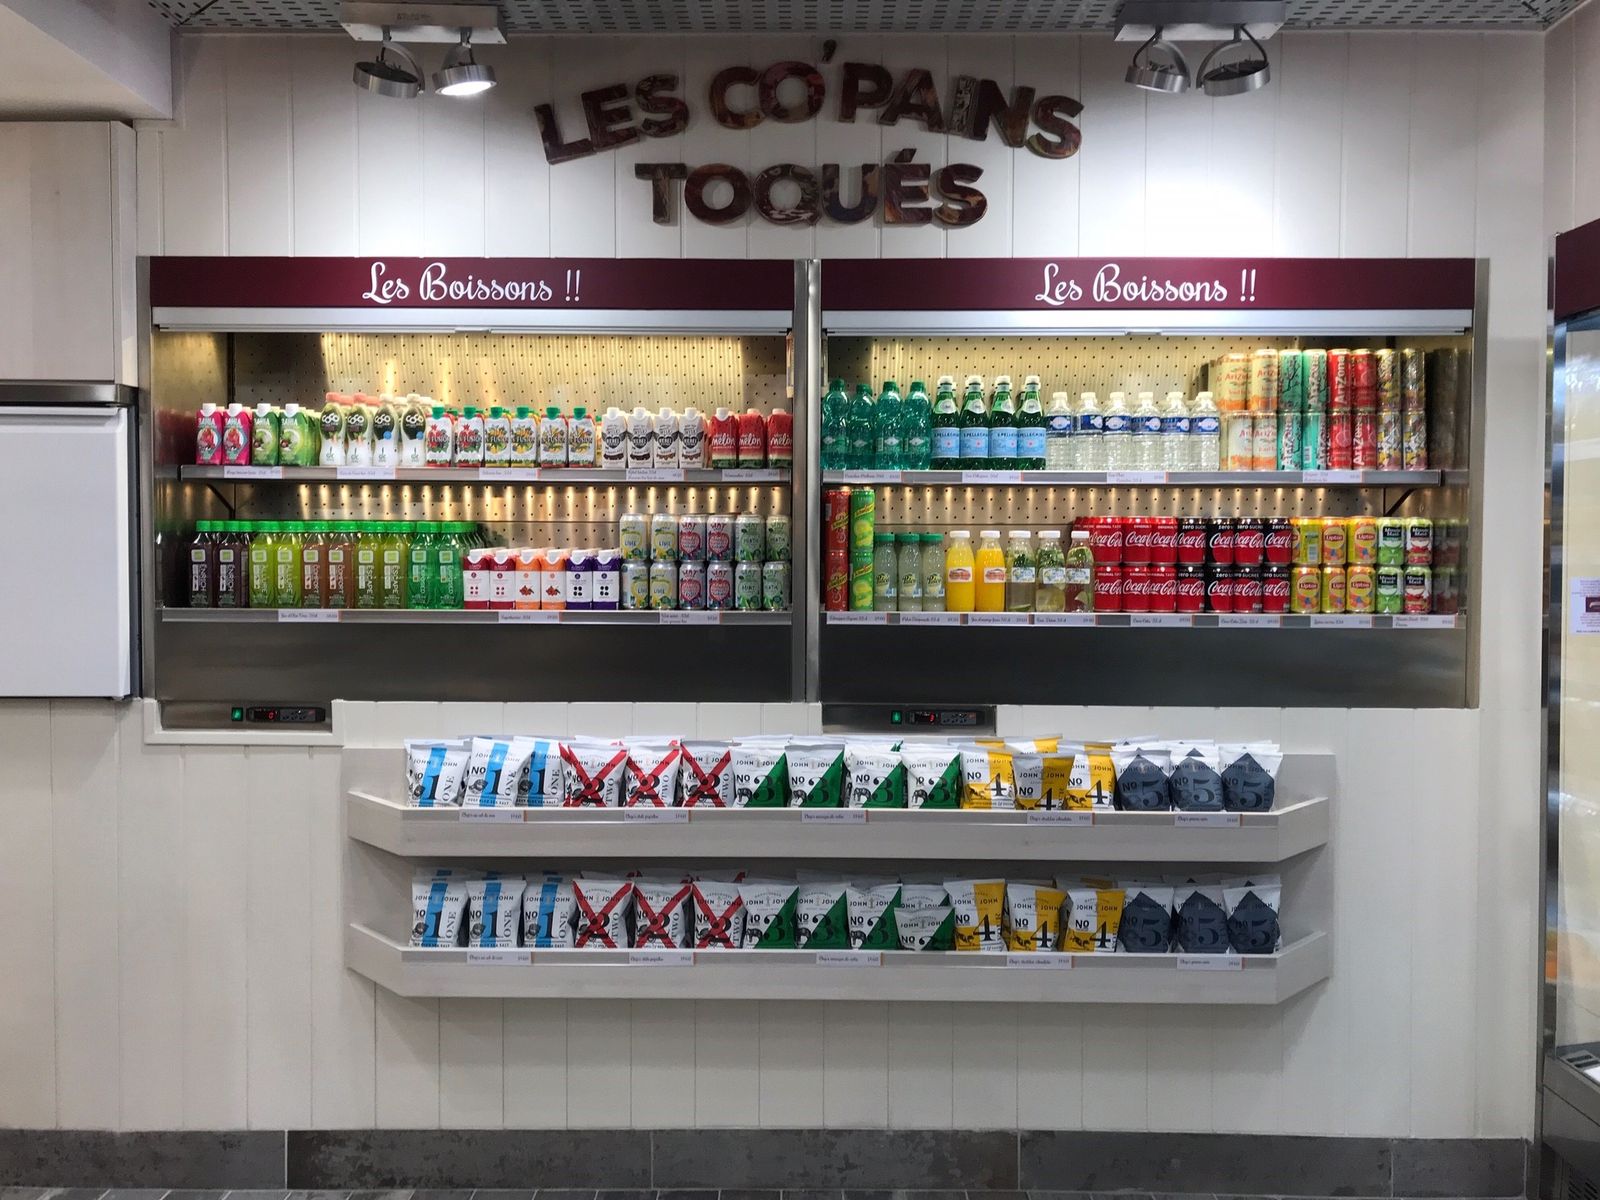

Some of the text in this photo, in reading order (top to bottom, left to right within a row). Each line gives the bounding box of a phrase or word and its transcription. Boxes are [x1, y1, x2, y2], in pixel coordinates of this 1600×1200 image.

[534, 39, 1085, 164] LES CO'PAINS
[634, 148, 988, 226] TOQUÉS
[362, 261, 580, 304] Les Boissons !!
[1035, 263, 1256, 306] Les Boissons !!
[471, 766, 486, 775] NO
[505, 770, 517, 797] ONE
[551, 769, 560, 796] ONE
[442, 776, 455, 801] ONE
[737, 774, 775, 800] NO 3
[791, 776, 830, 802] NO 3
[856, 775, 893, 802] NO 3
[928, 777, 949, 802] 3
[967, 772, 1007, 797] NO 4
[1068, 778, 1108, 805] NO 4
[1122, 779, 1164, 807] NO 5
[1175, 777, 1215, 803] NO 5
[1224, 777, 1262, 808] NO 5
[1019, 787, 1056, 810] NO 4
[446, 912, 456, 938] ONE
[504, 911, 512, 937] ONE
[525, 911, 538, 920] NO
[559, 912, 568, 938] ONE
[764, 914, 785, 941] 3
[813, 914, 833, 942] 3
[956, 914, 995, 941] NO 4
[851, 916, 888, 944] NO 3
[902, 935, 915, 944] NO
[1015, 919, 1052, 948] NO 4
[1075, 920, 1111, 949] NO 4
[1140, 919, 1161, 947] 5
[1199, 919, 1219, 945] 5
[1252, 920, 1271, 946] 5
